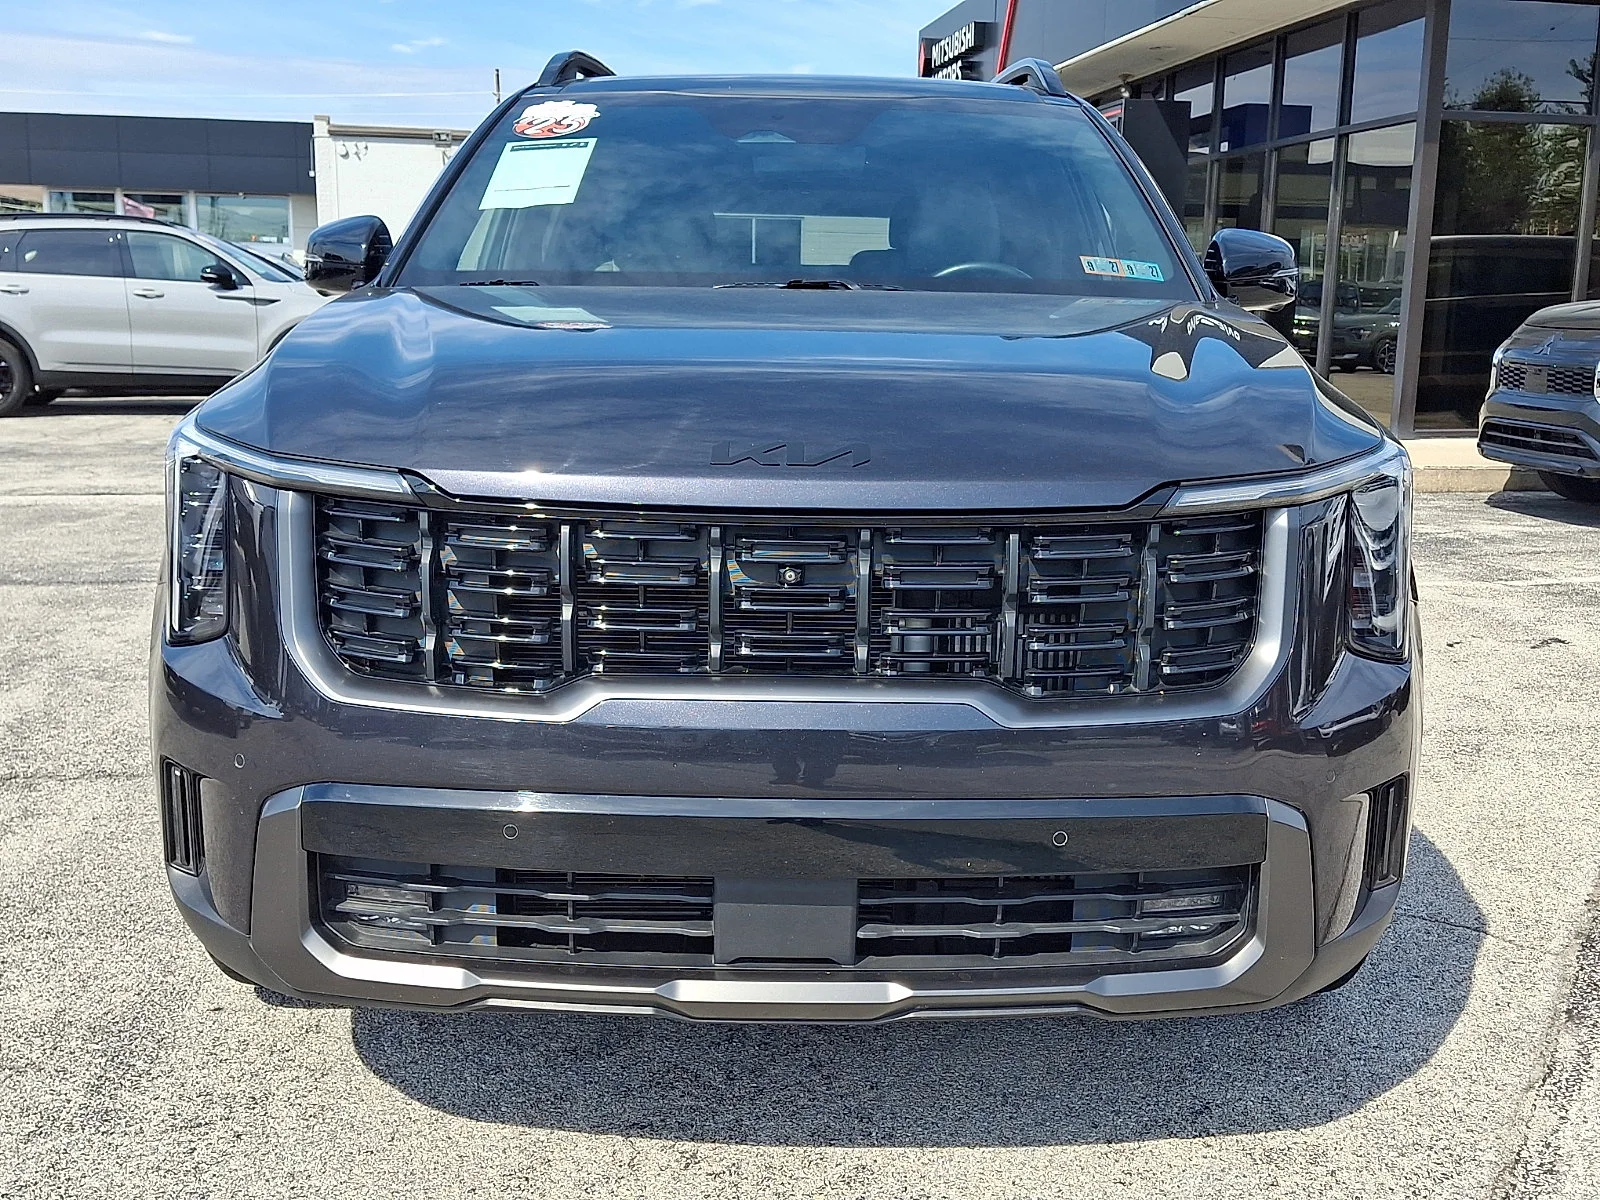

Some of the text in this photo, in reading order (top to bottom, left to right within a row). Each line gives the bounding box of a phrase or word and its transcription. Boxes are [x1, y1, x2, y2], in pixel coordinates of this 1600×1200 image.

[931, 22, 975, 68] MITSUBISHI
[932, 59, 962, 80] TORS
[1087, 261, 1120, 274] 9 27
[1127, 264, 1159, 278] 9 27
